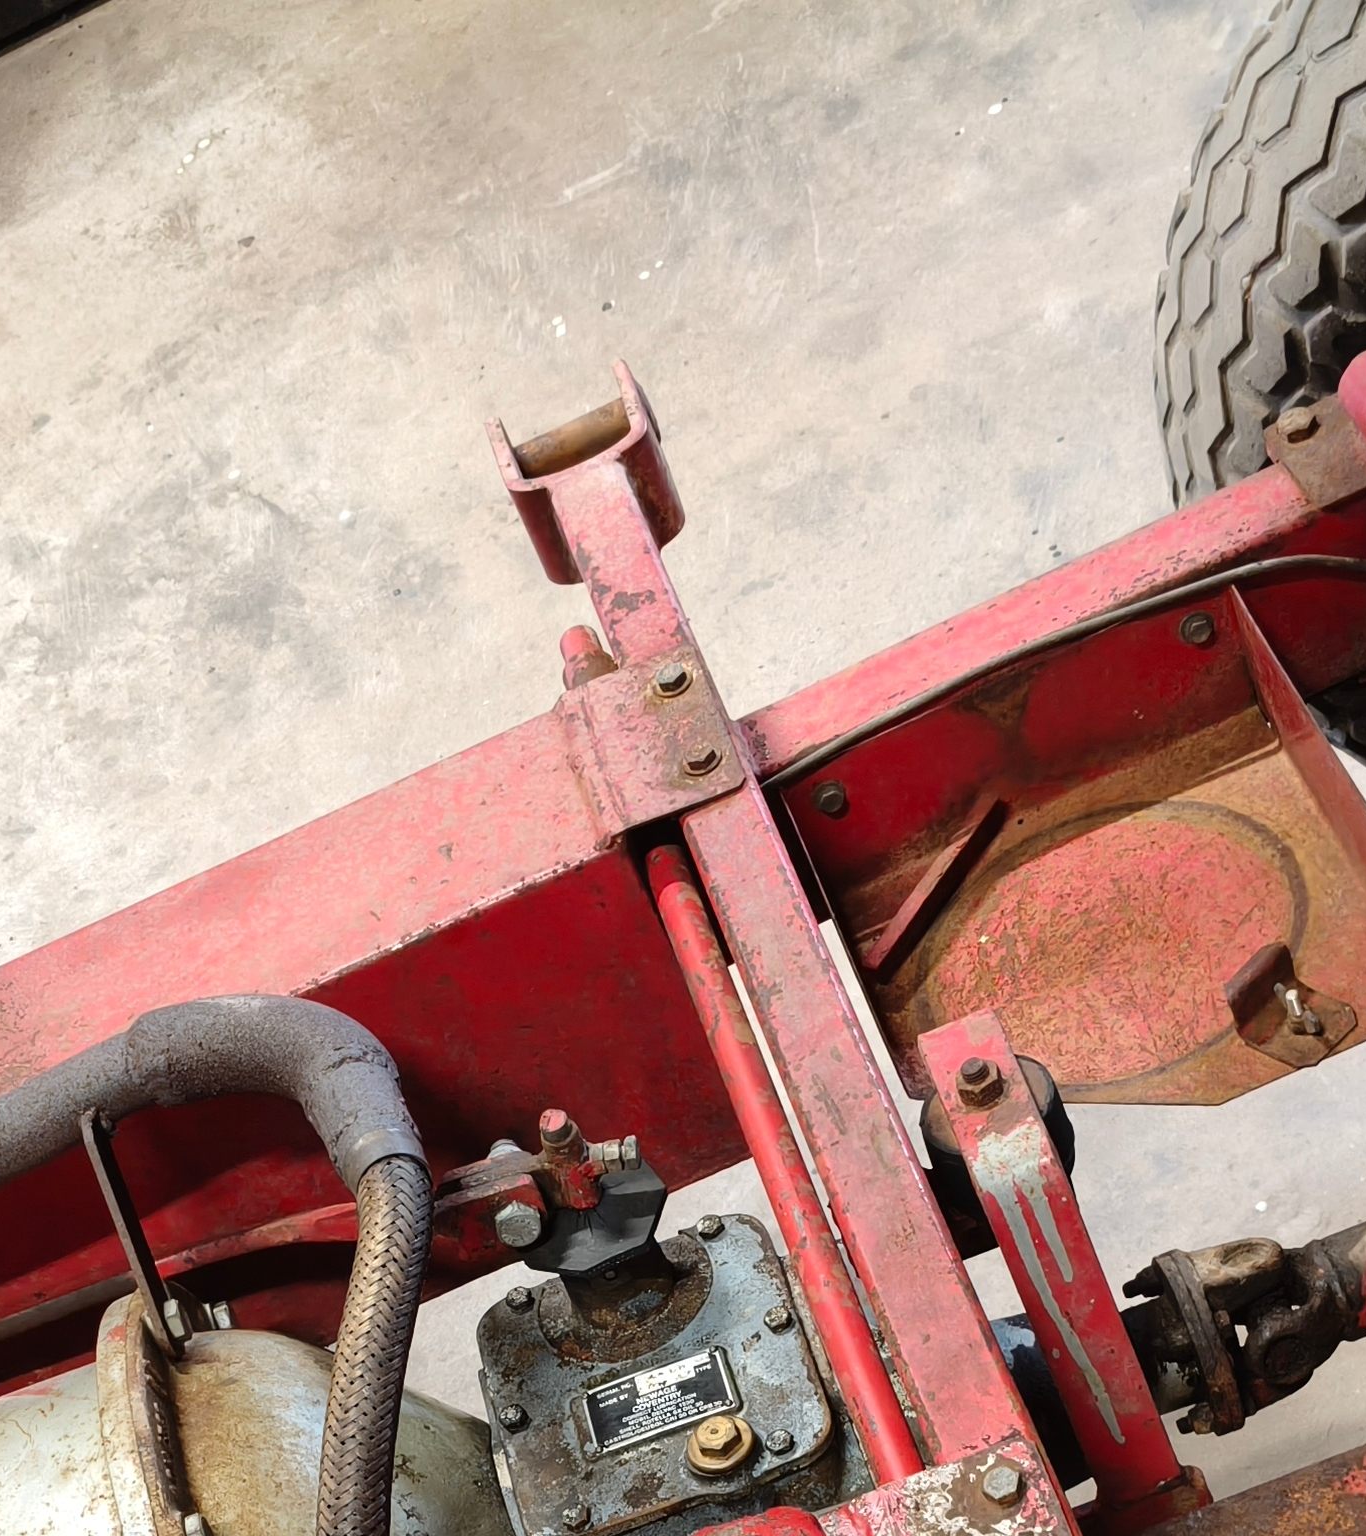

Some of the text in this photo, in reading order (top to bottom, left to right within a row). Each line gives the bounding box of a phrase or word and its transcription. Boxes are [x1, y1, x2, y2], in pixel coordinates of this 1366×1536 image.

[599, 1393, 629, 1408] MADE BY
[631, 1390, 682, 1413] COVENTRY
[636, 1385, 678, 1404] NEWAGE
[621, 1392, 697, 1423] CORRECT LUBRICATION
[628, 1412, 651, 1426] MOBIL
[651, 1405, 676, 1417] DELVAC
[619, 1423, 640, 1434] SHELL
[641, 1412, 672, 1426] ROTELLA
[683, 1404, 694, 1412] OIL
